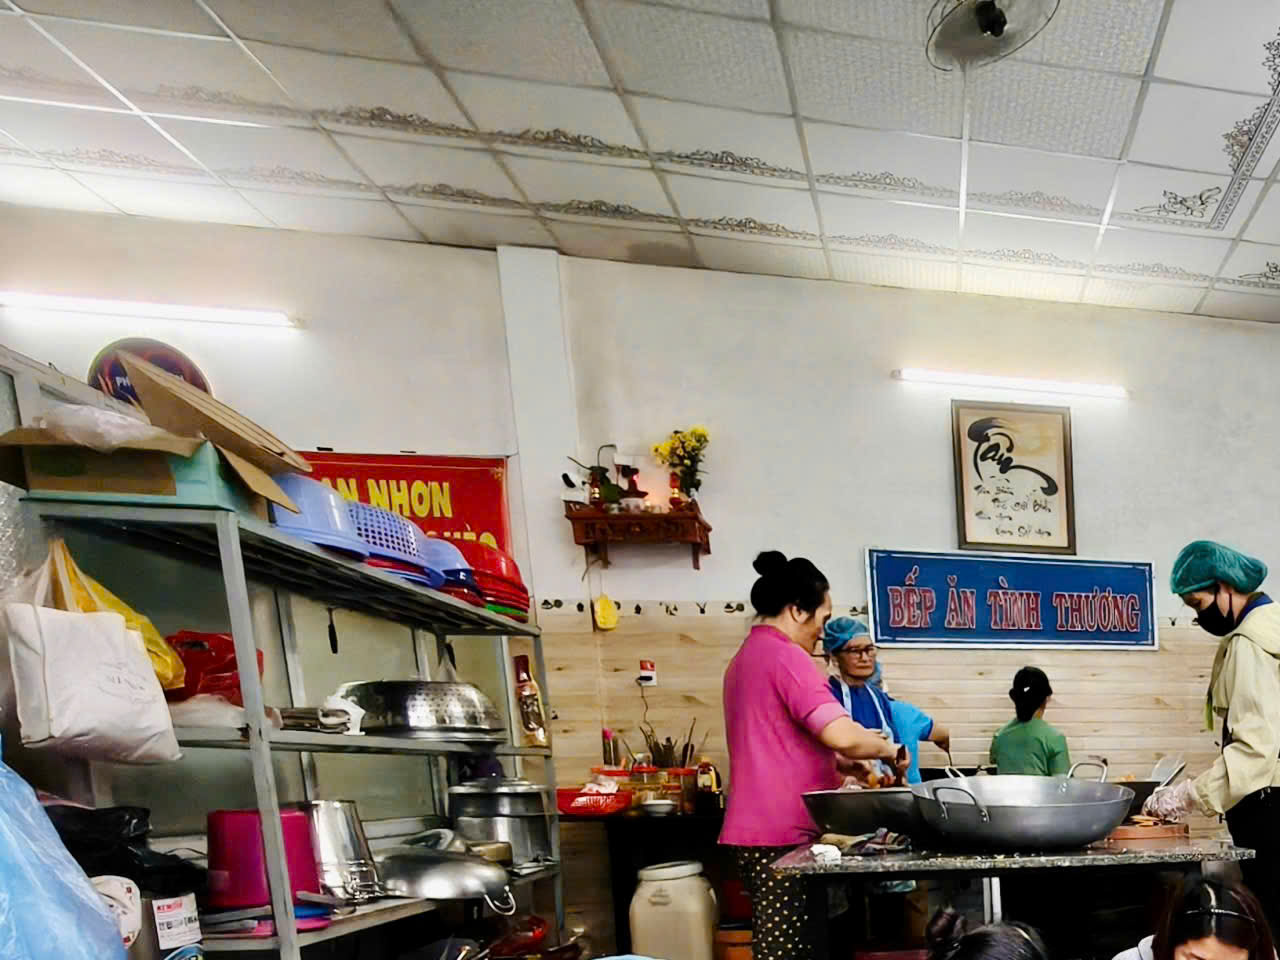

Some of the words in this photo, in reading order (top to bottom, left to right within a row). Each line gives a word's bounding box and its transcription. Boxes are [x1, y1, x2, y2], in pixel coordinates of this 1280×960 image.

[366, 479, 453, 518] NHƠN
[887, 565, 936, 629] BẾP
[944, 574, 977, 630] ĂN
[986, 575, 1043, 631] TÌNH
[1052, 585, 1141, 633] THƯƠNG
